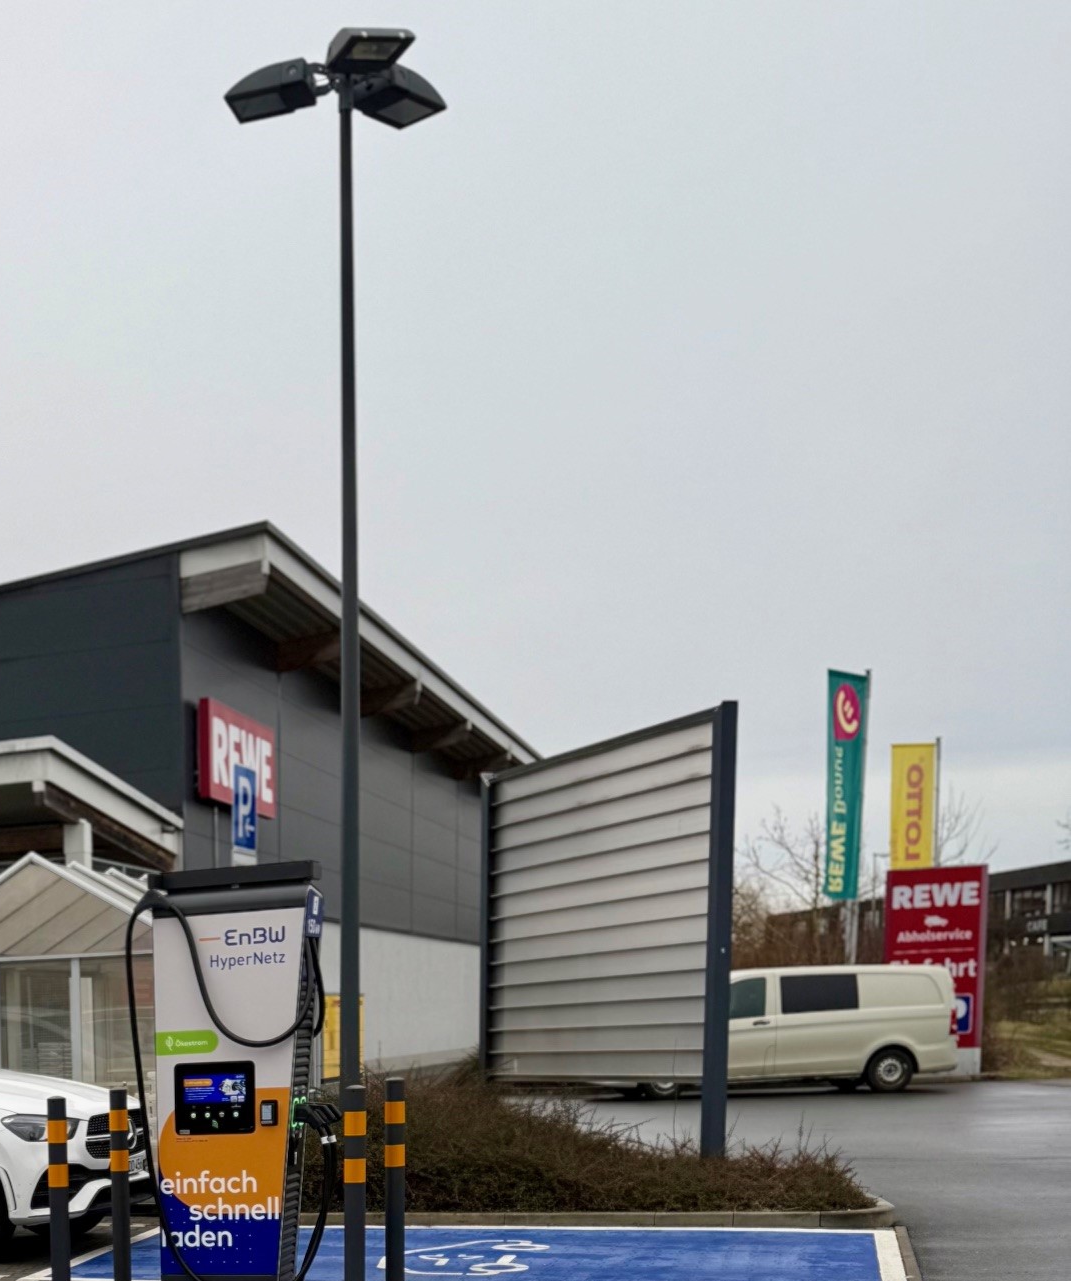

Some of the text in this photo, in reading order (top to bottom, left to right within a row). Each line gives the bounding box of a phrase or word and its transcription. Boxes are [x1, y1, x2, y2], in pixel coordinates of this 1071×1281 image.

[212, 716, 274, 804] REWE
[238, 776, 253, 838] P
[892, 880, 980, 911] REWE
[224, 925, 286, 946] EnBW
[897, 927, 973, 944] Abholservice
[209, 951, 286, 971] HyperNetz
[160, 1169, 257, 1195] einfach
[189, 1196, 280, 1220] schnell
